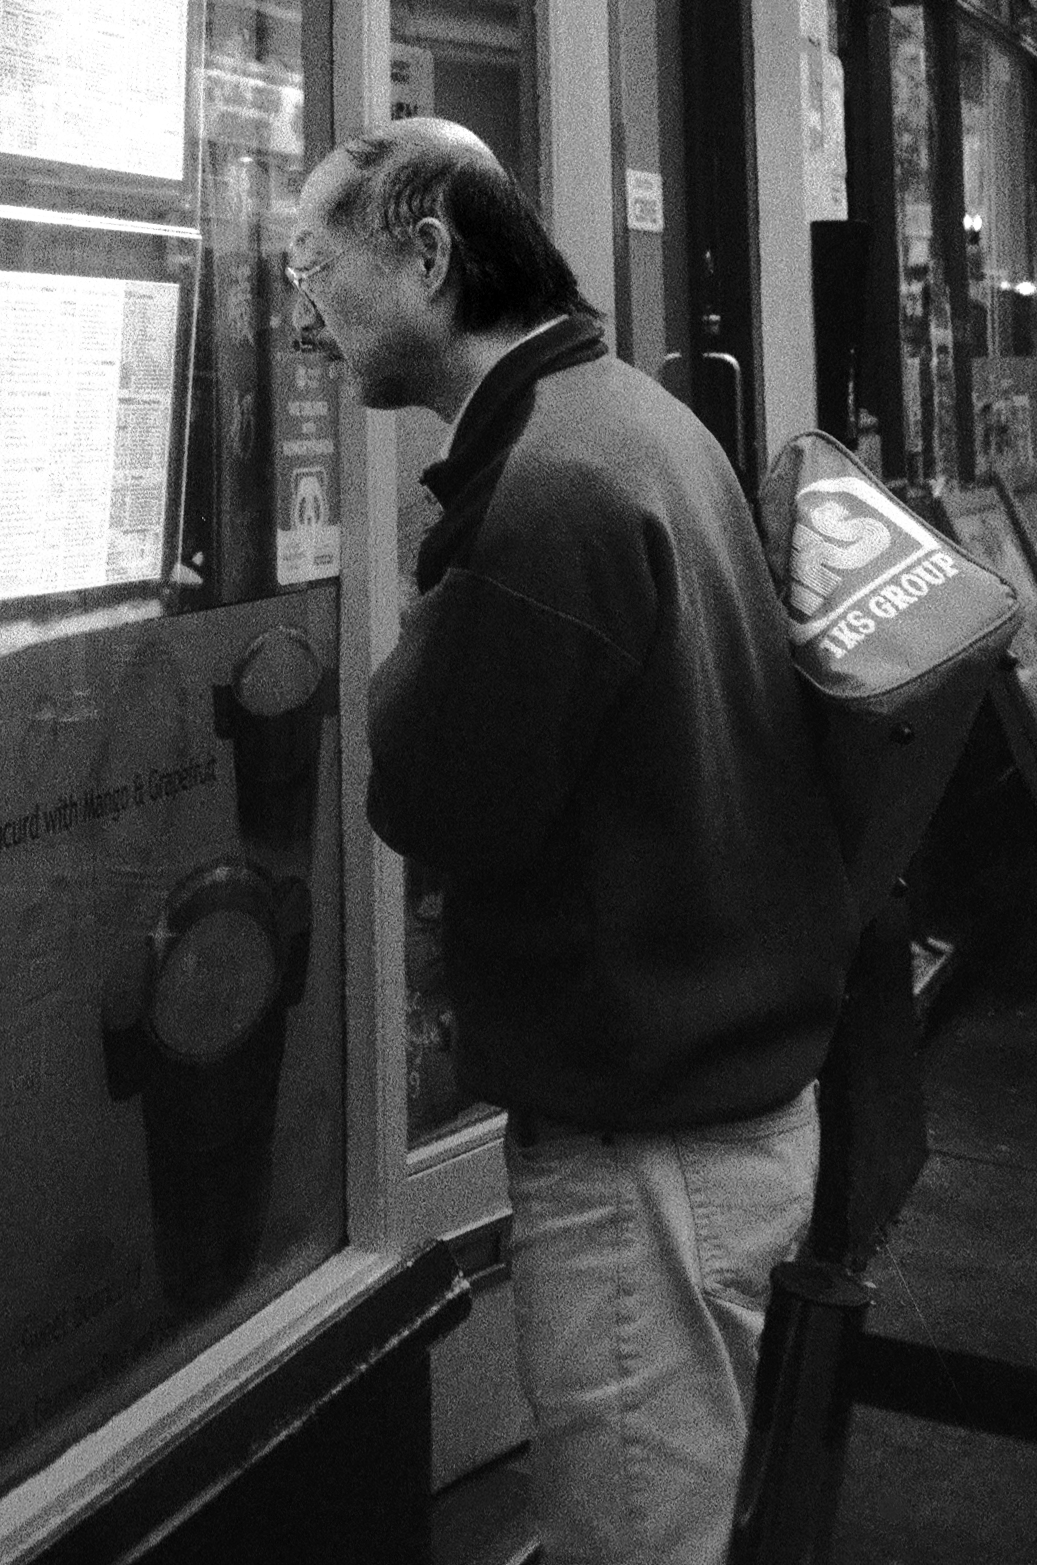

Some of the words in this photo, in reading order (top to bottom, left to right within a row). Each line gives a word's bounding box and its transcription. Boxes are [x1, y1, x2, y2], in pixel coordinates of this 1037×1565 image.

[868, 552, 961, 620] GROUP
[43, 792, 79, 834] with
[83, 785, 128, 823] Mango
[133, 772, 146, 807] &
